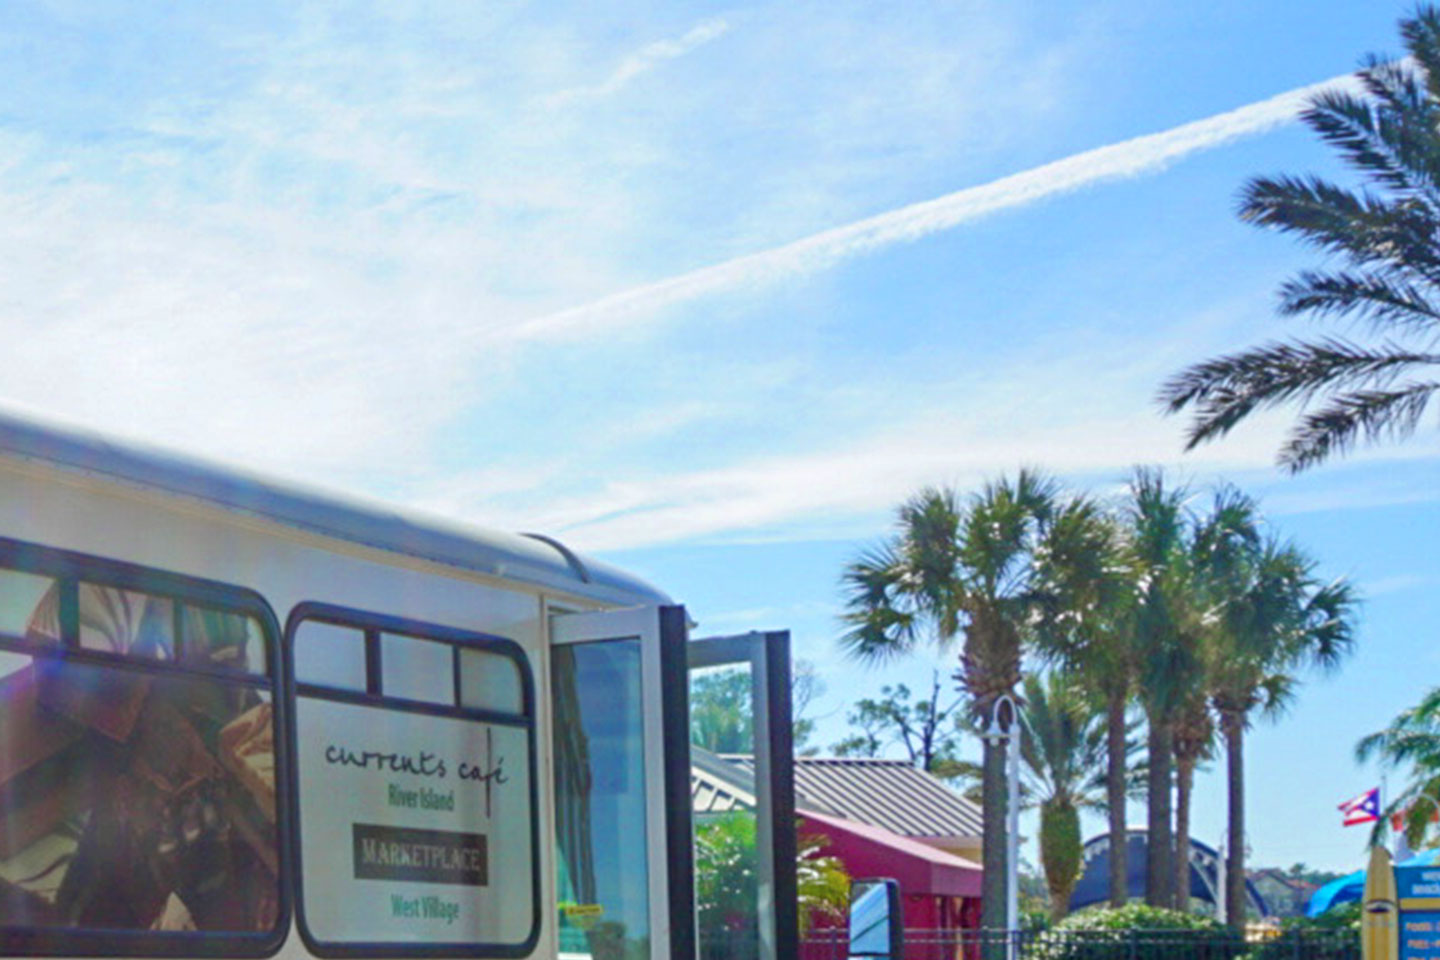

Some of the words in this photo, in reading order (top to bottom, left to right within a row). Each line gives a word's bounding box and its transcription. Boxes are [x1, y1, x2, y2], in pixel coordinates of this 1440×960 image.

[325, 745, 447, 778] currents
[388, 783, 418, 809] River
[420, 787, 455, 812] Island
[362, 838, 481, 871] MARKETPLACE
[390, 893, 420, 918] West
[421, 895, 460, 925] Village
